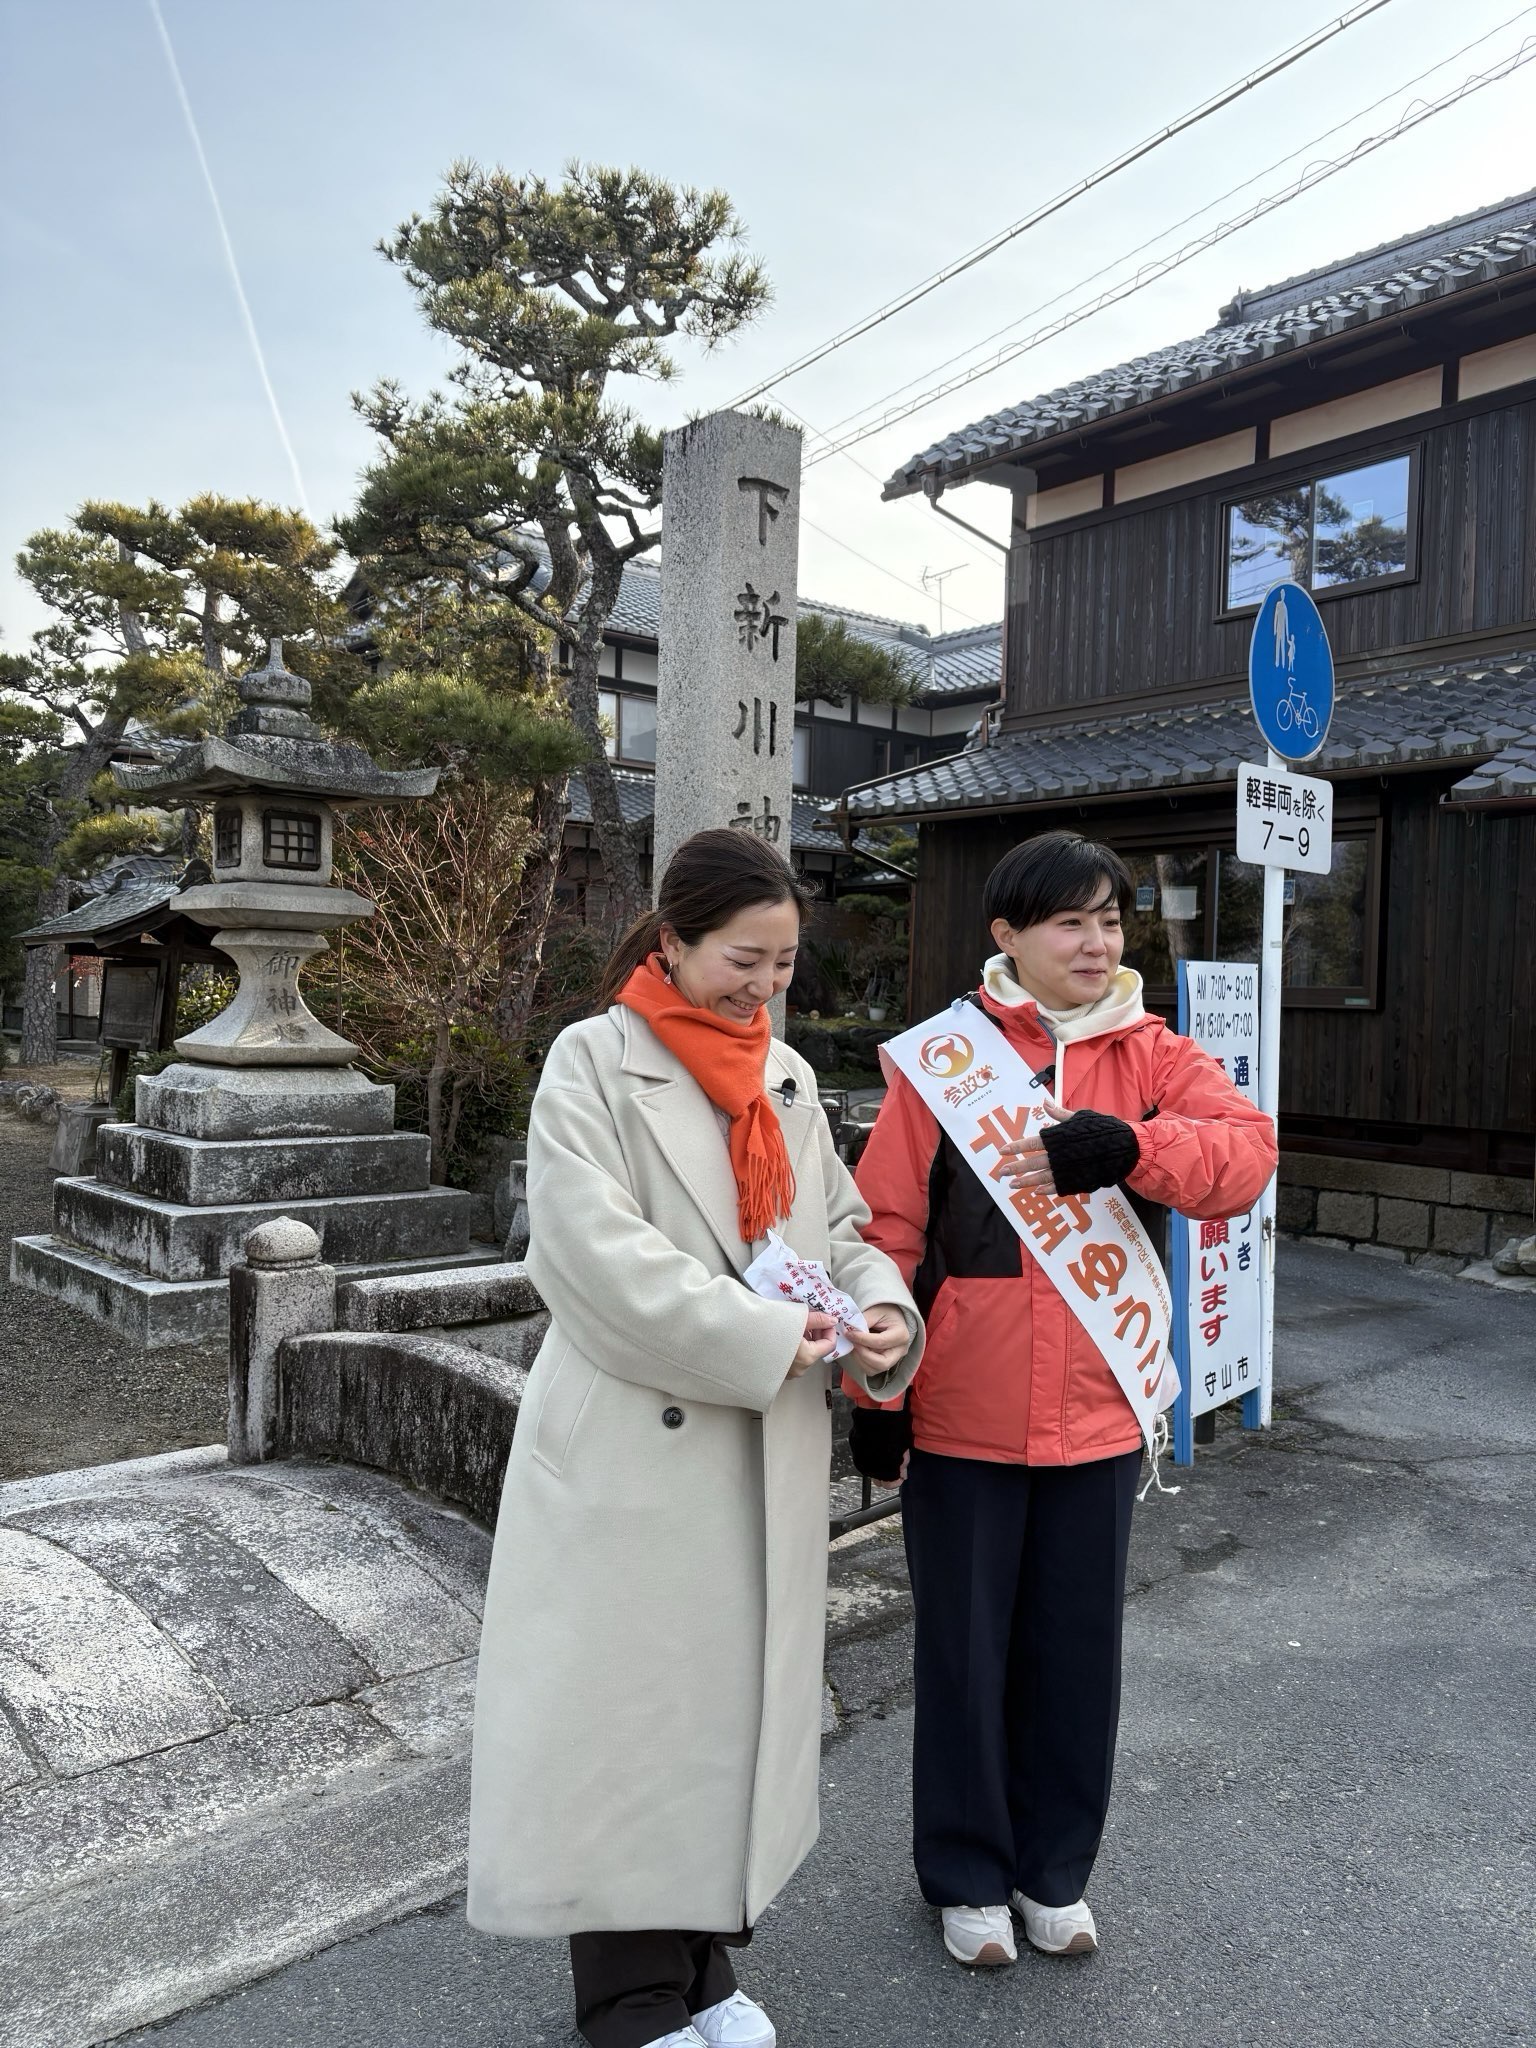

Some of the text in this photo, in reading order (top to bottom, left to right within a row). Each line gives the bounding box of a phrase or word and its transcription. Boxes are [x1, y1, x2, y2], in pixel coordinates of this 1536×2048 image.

[1246, 776, 1325, 822] 軽車両を除く
[1196, 974, 1207, 1000] AM
[1235, 975, 1253, 1000] 9:00
[1195, 1013, 1206, 1039] PM
[943, 1064, 1000, 1109] 参政党
[1199, 1217, 1230, 1347] 願います
[1204, 1355, 1249, 1397] 守山市
